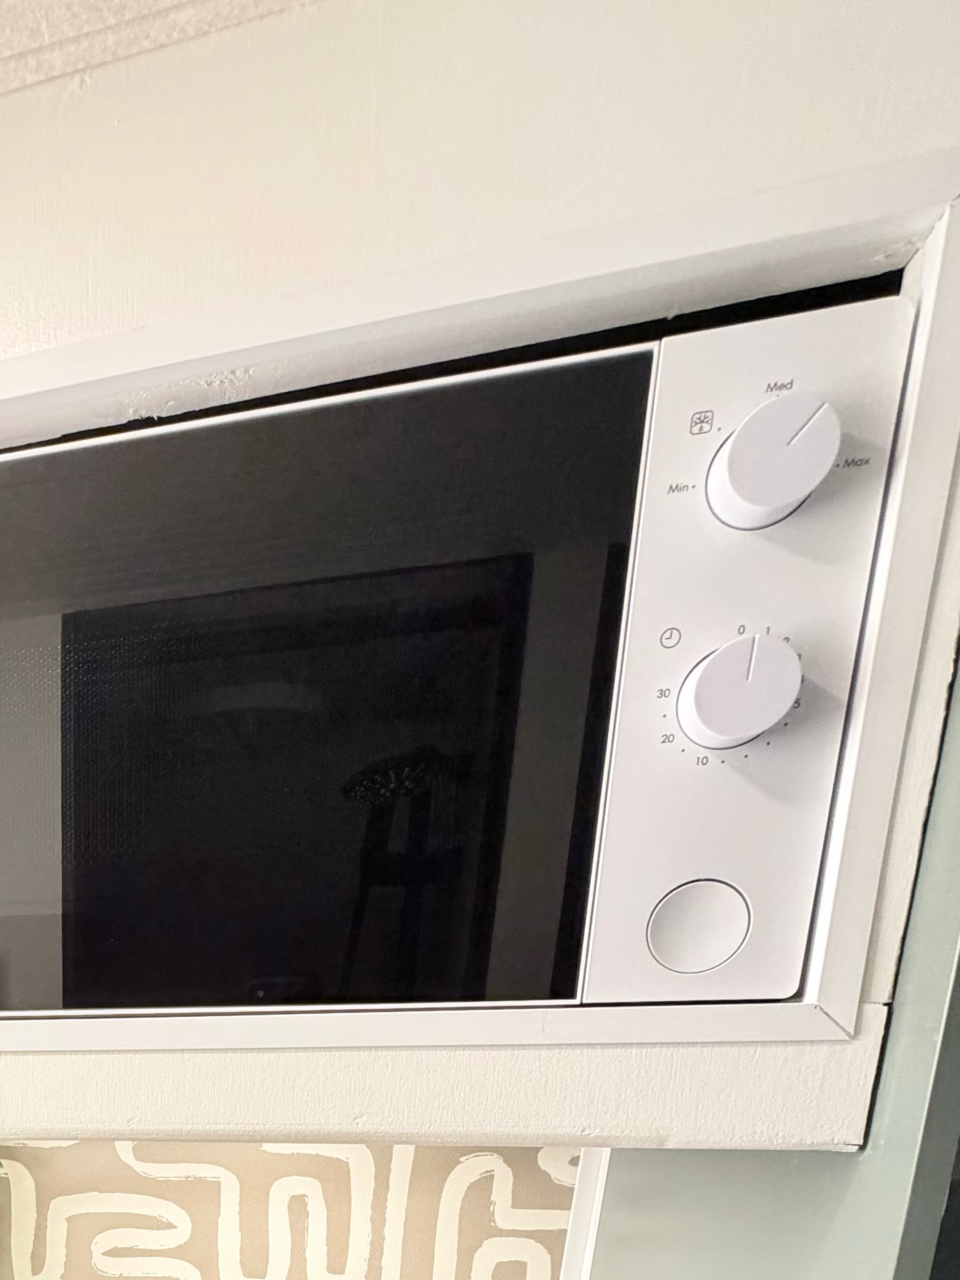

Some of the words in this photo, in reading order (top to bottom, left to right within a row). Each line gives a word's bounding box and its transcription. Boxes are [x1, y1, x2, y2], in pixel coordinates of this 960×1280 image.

[765, 379, 794, 394] Med
[842, 456, 871, 469] Max
[667, 482, 690, 495] Min
[737, 625, 746, 635] 0
[656, 688, 671, 699] 30
[660, 733, 675, 745] 20
[695, 756, 709, 767] 10
